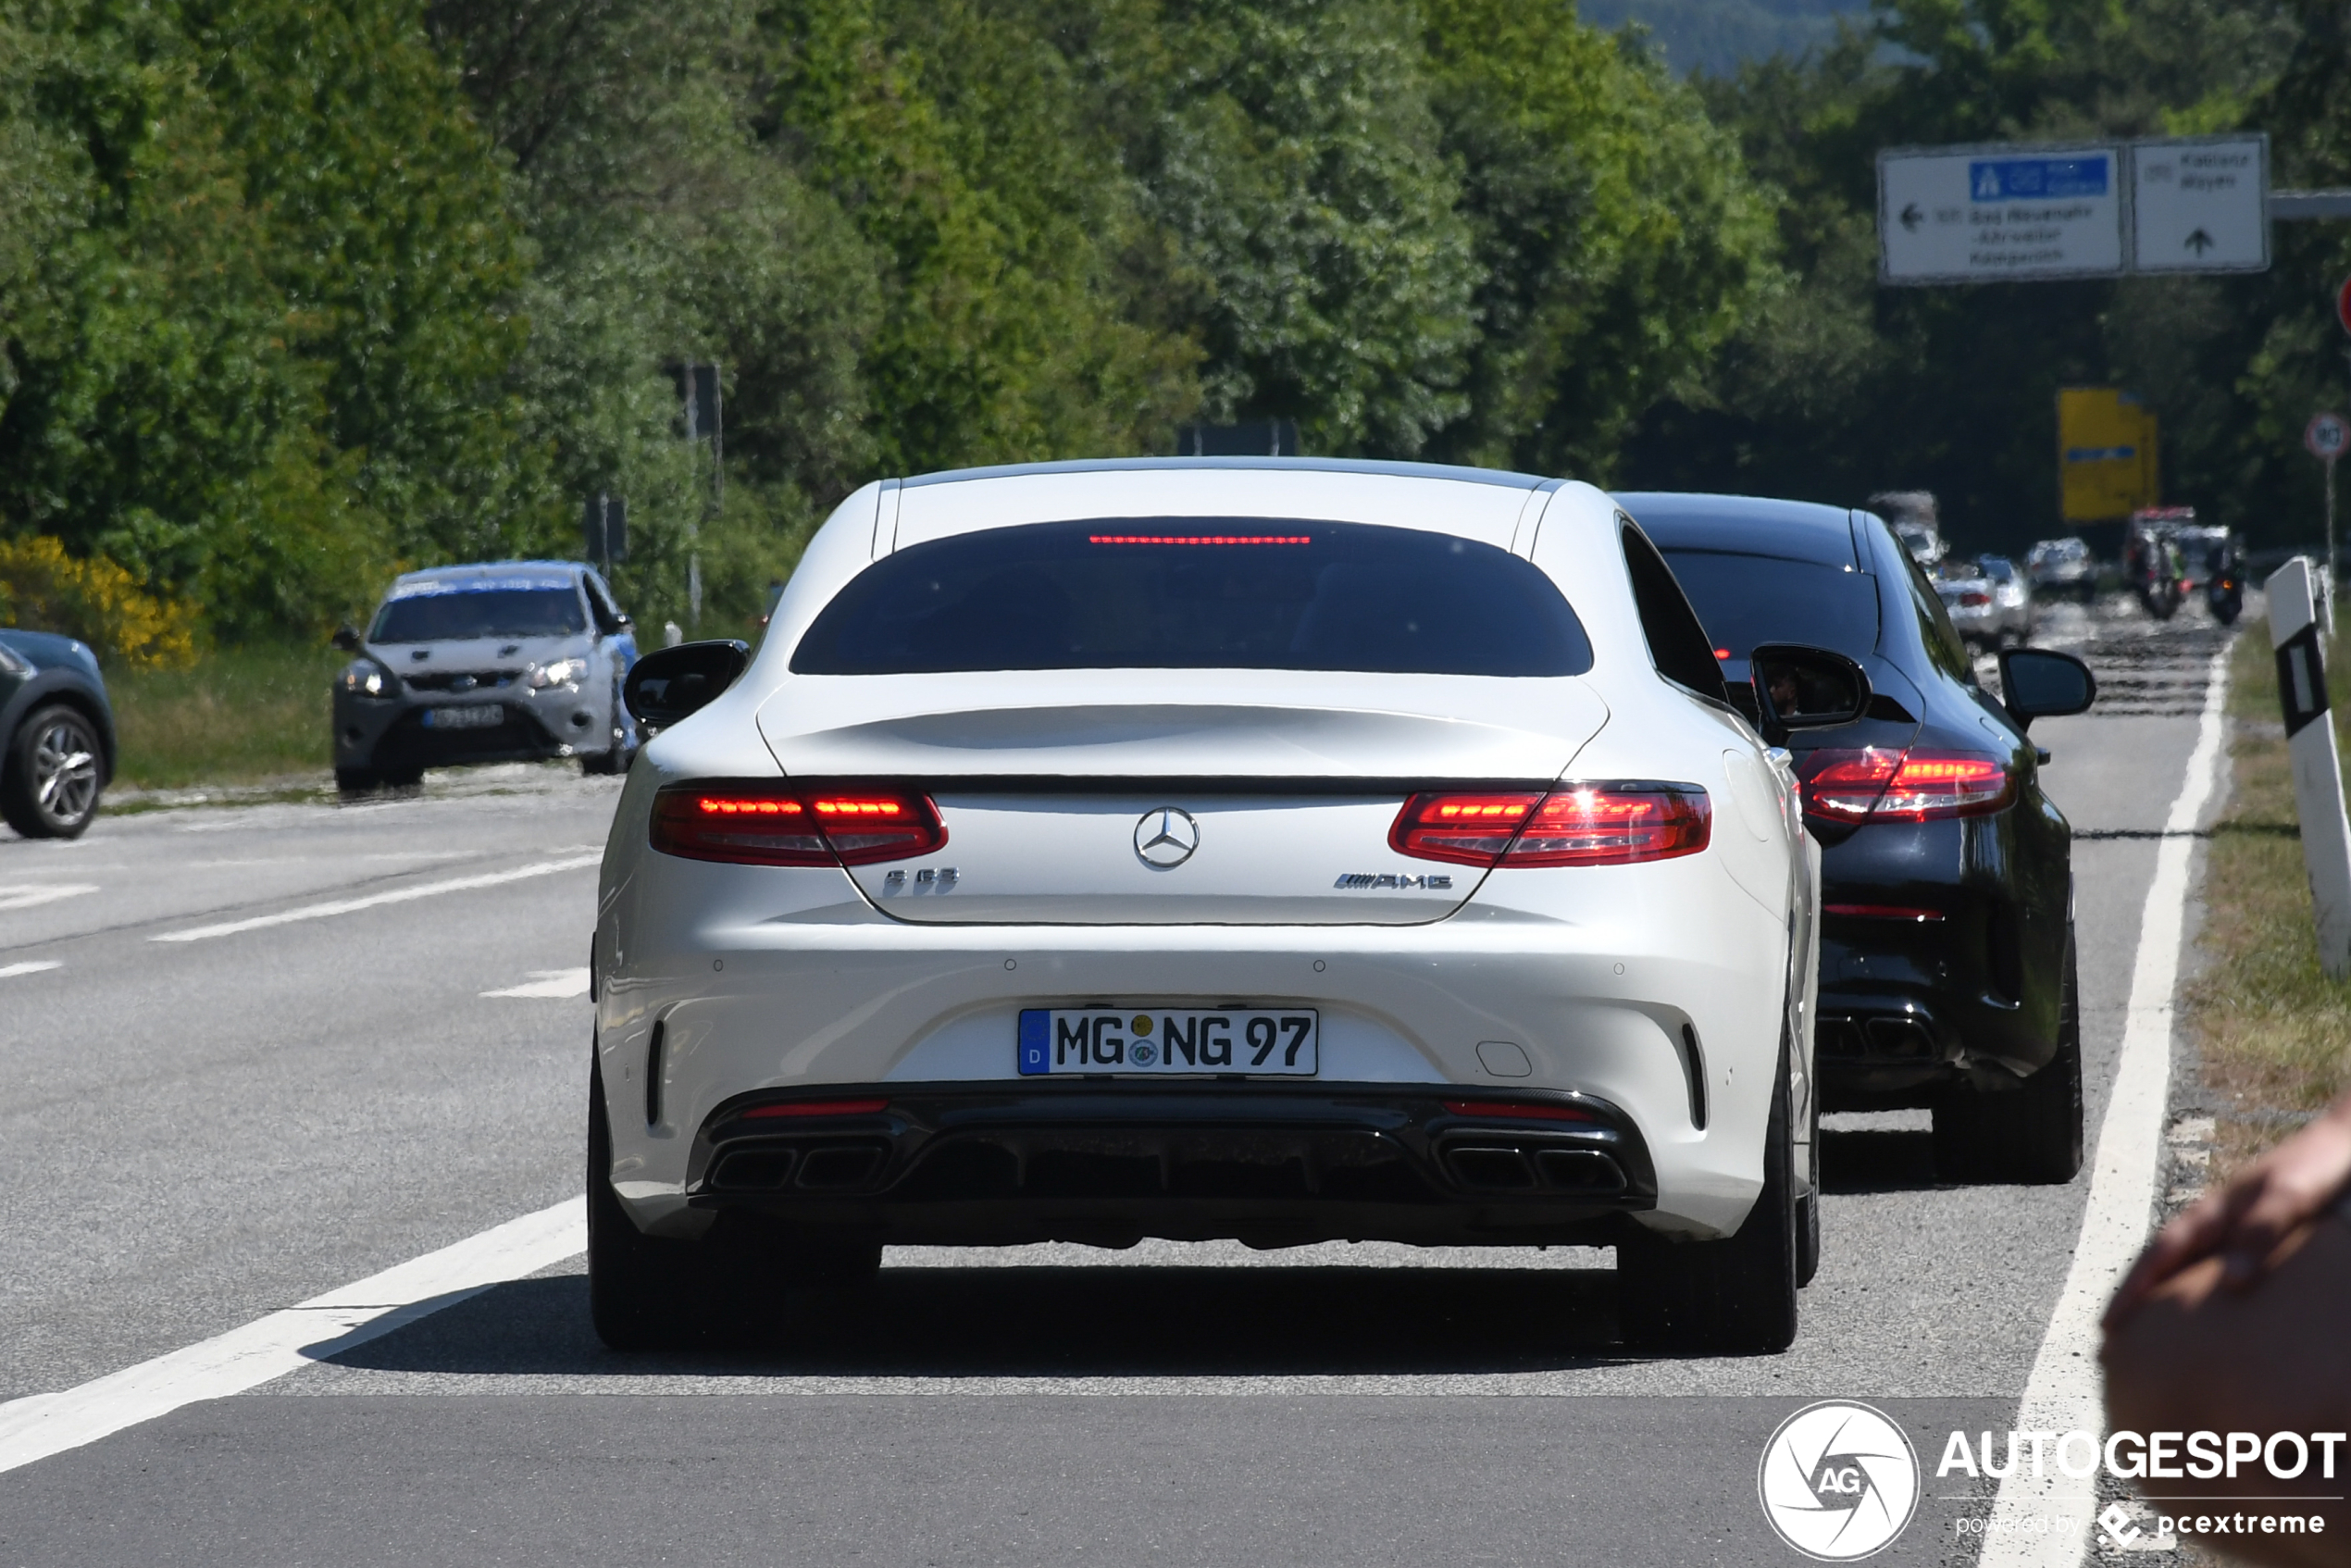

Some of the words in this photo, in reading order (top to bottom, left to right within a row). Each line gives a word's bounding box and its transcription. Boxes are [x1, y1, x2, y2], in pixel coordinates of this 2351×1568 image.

[1029, 1050, 1040, 1064] D
[1057, 1017, 1124, 1064] MG
[1163, 1017, 1232, 1065] NG
[1246, 1017, 1312, 1066] 97
